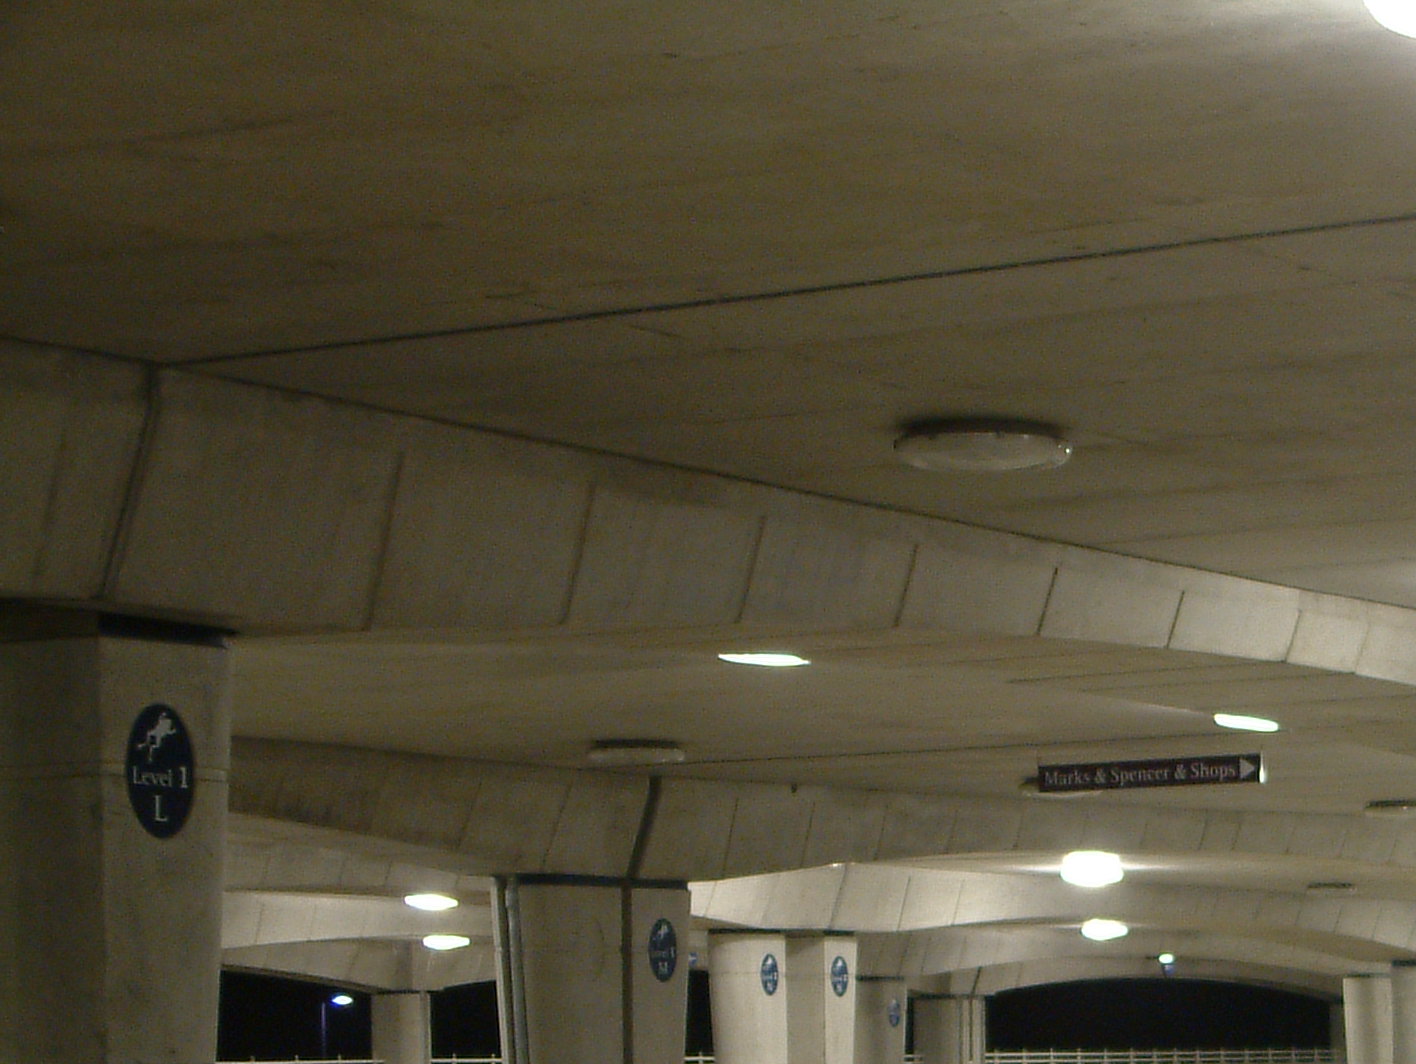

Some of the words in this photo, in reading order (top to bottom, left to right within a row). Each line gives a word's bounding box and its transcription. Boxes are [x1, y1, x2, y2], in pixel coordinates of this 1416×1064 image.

[132, 766, 173, 788] Level
[1043, 770, 1091, 786] Marks
[1094, 769, 1107, 785] &
[1109, 766, 1170, 787] Spencer
[1174, 764, 1187, 780] &
[1189, 761, 1236, 782] Shops
